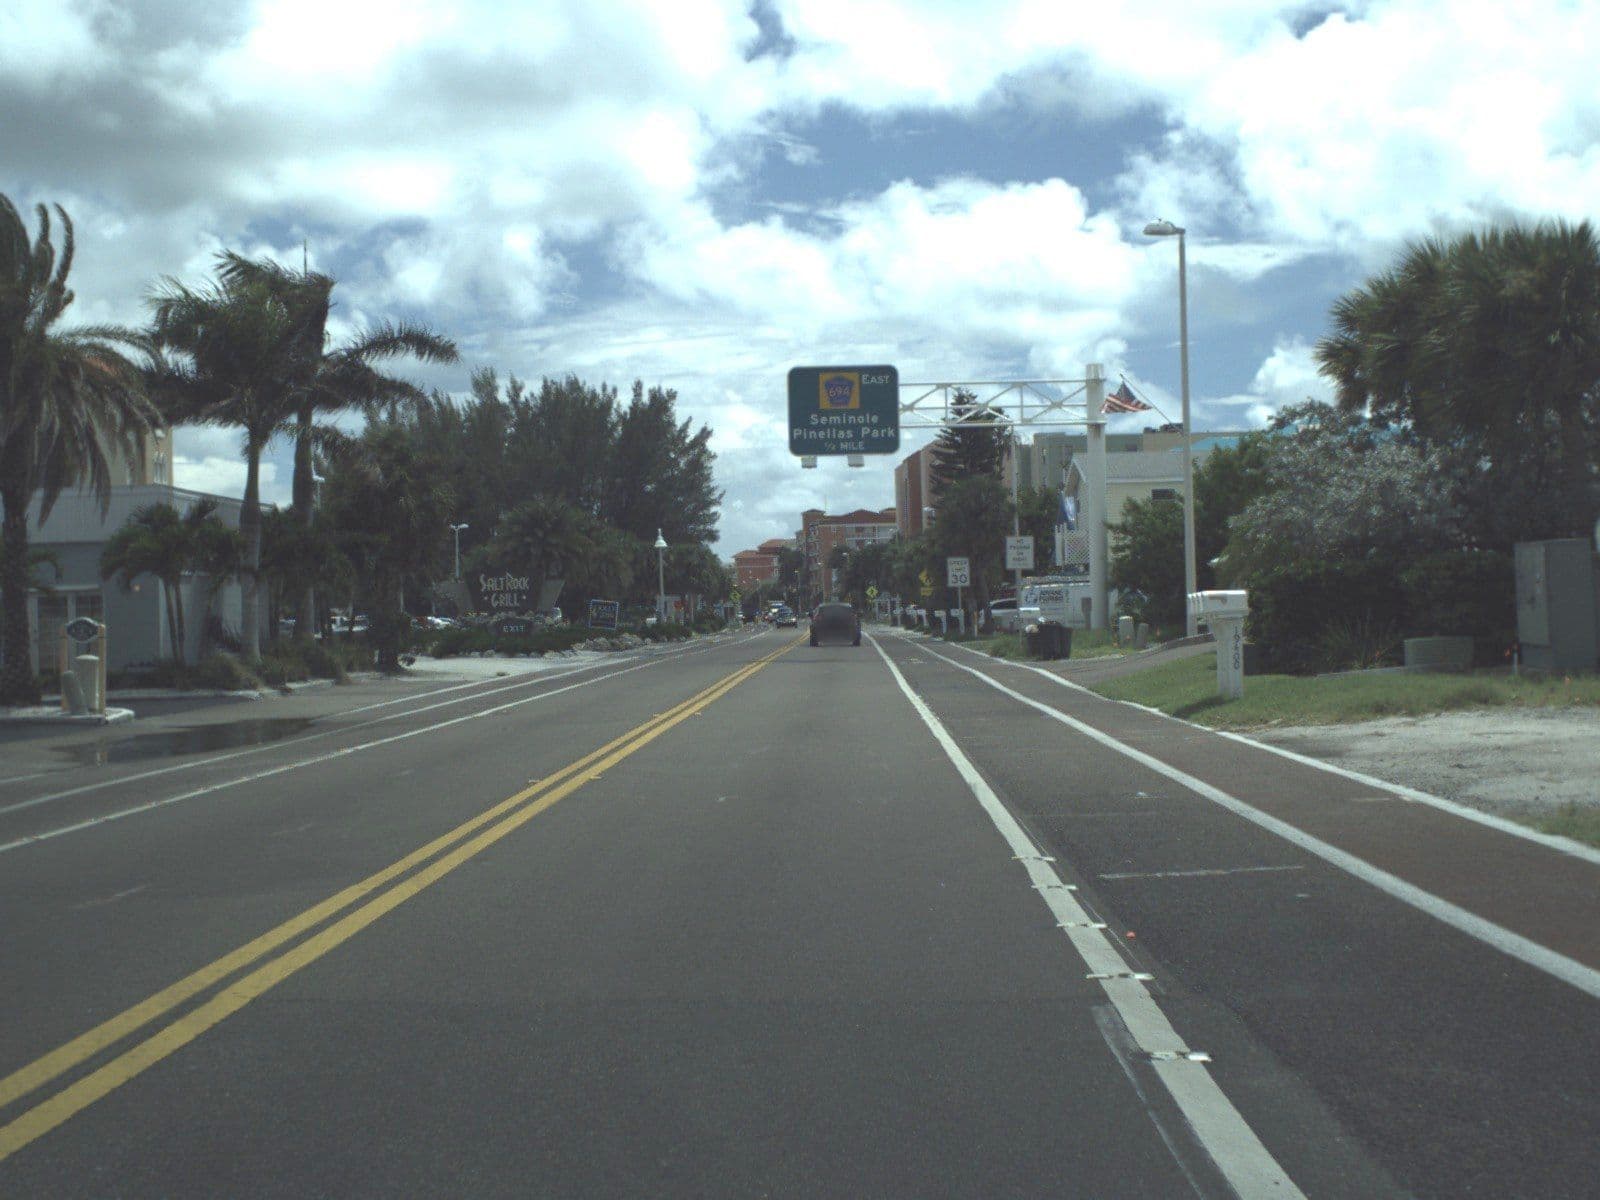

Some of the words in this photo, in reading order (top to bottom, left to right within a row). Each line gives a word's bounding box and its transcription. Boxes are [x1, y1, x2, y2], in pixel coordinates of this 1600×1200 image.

[861, 374, 889, 384] EAST
[828, 385, 851, 397] 694
[810, 413, 879, 425] Seminole
[793, 428, 854, 439] Pinellas
[861, 426, 896, 437] Park
[840, 441, 865, 450] MILE
[479, 573, 506, 592] SALT
[505, 571, 530, 591] ROCK
[951, 573, 968, 584] 30
[491, 593, 520, 608] GRILL
[503, 625, 525, 633] EXIT
